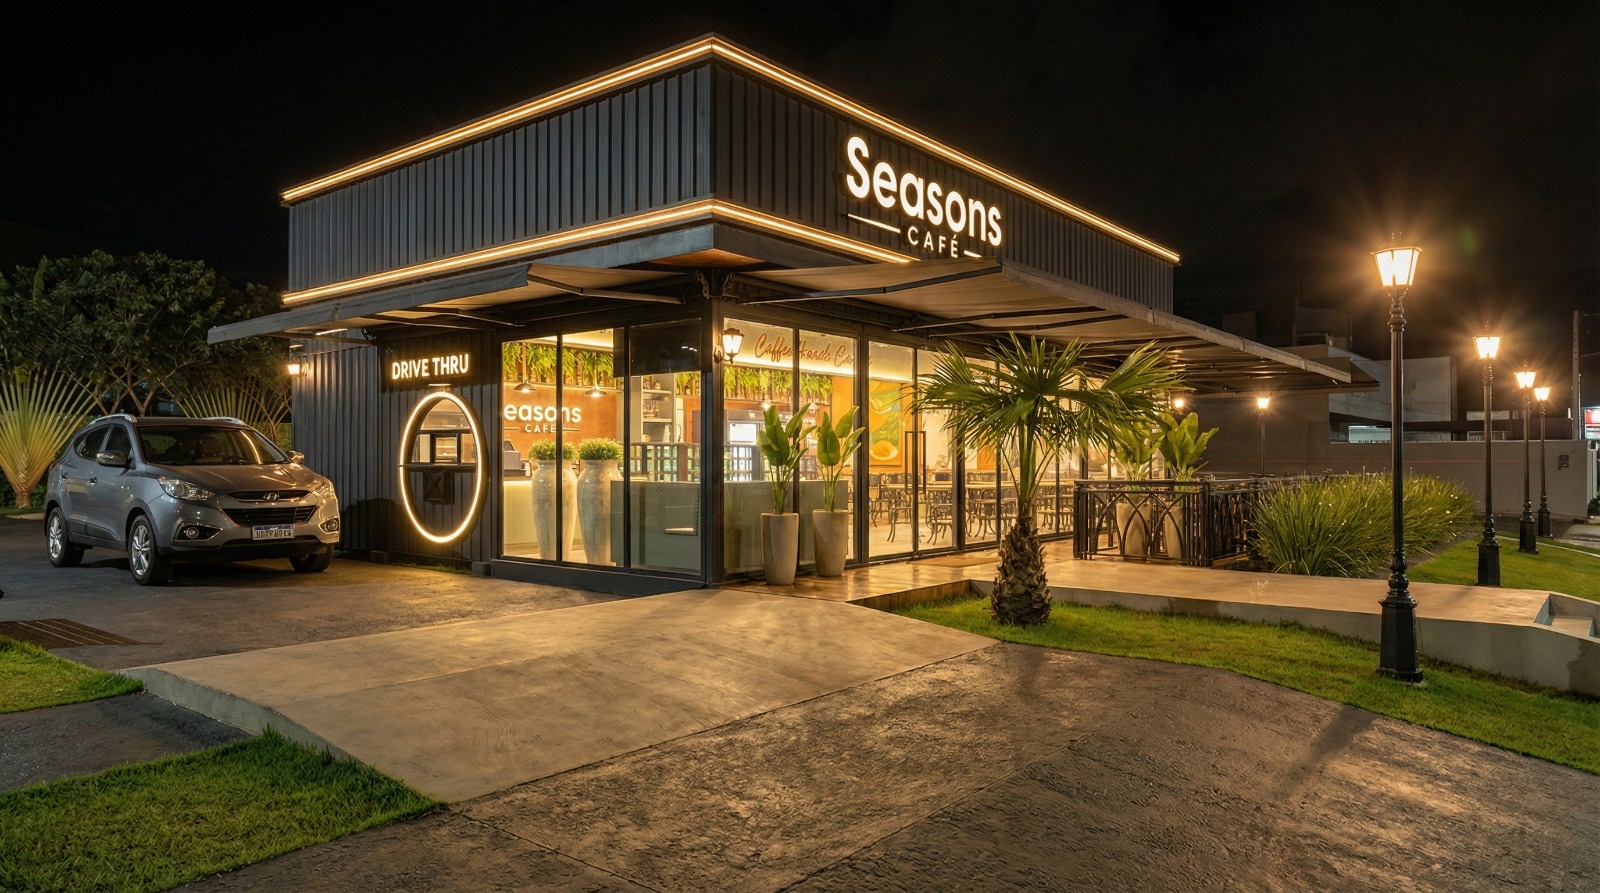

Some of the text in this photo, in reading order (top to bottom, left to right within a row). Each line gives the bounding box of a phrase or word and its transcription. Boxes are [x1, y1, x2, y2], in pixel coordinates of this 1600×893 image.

[847, 136, 1002, 246] Seasons
[907, 226, 959, 258] CAFÉ
[392, 354, 469, 380] DRIVE THRU
[503, 403, 582, 424] easons
